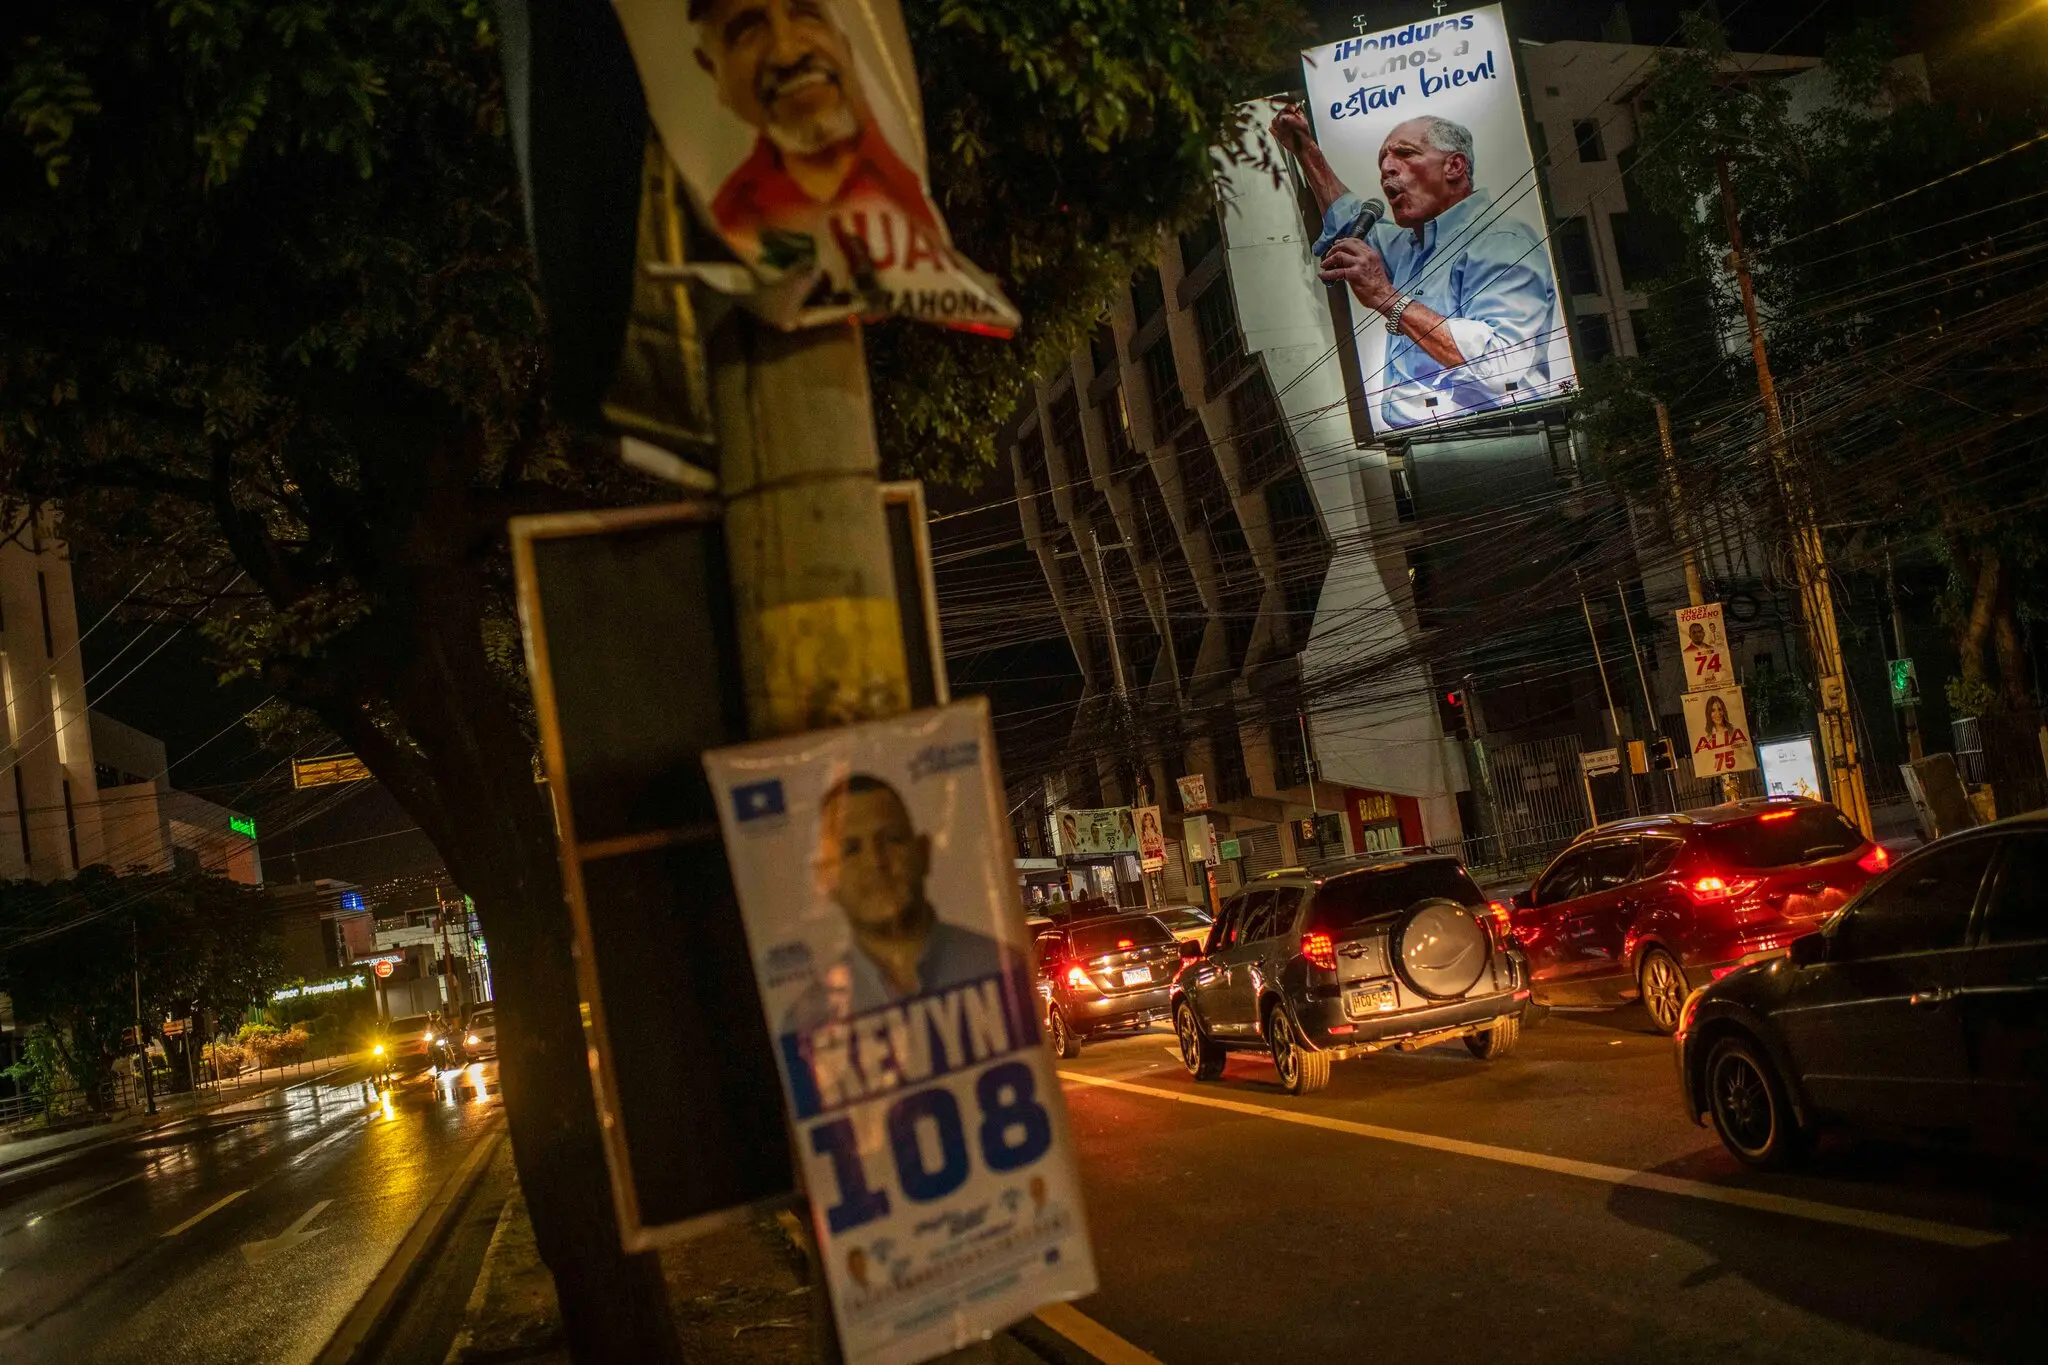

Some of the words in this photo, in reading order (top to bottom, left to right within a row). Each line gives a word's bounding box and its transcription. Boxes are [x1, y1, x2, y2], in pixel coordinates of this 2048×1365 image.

[1452, 39, 1469, 57] a
[1330, 84, 1406, 120] estar
[1419, 50, 1497, 97] bien!
[1694, 653, 1722, 676] 74
[1694, 728, 1748, 754] ALIA
[1714, 750, 1736, 772] 75
[1106, 836, 1116, 845] 93
[812, 979, 1010, 1107] KEVYN
[811, 1061, 1051, 1234] 108
